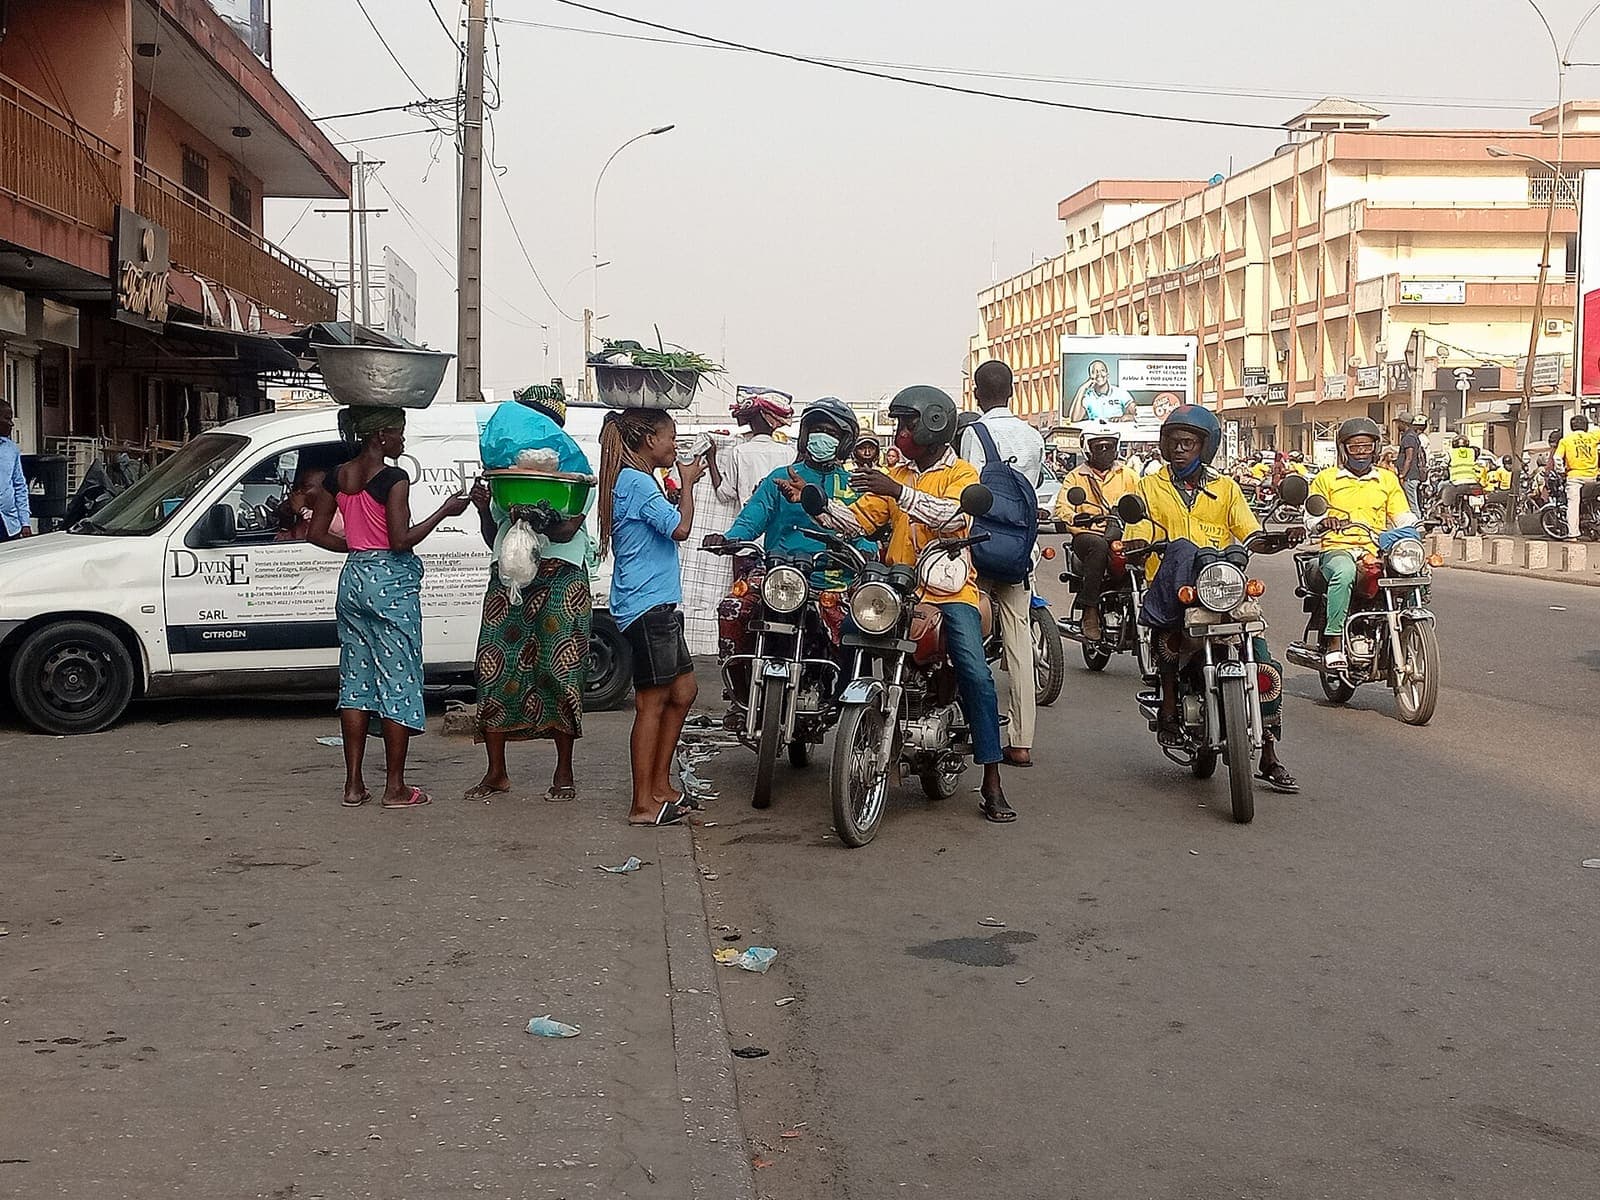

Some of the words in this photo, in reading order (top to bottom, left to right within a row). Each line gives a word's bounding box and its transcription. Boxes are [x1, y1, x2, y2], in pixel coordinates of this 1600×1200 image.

[169, 549, 250, 585] DIVINE
[203, 575, 232, 585] WAY
[198, 609, 228, 620] SARL
[202, 629, 247, 639] CITROËN
